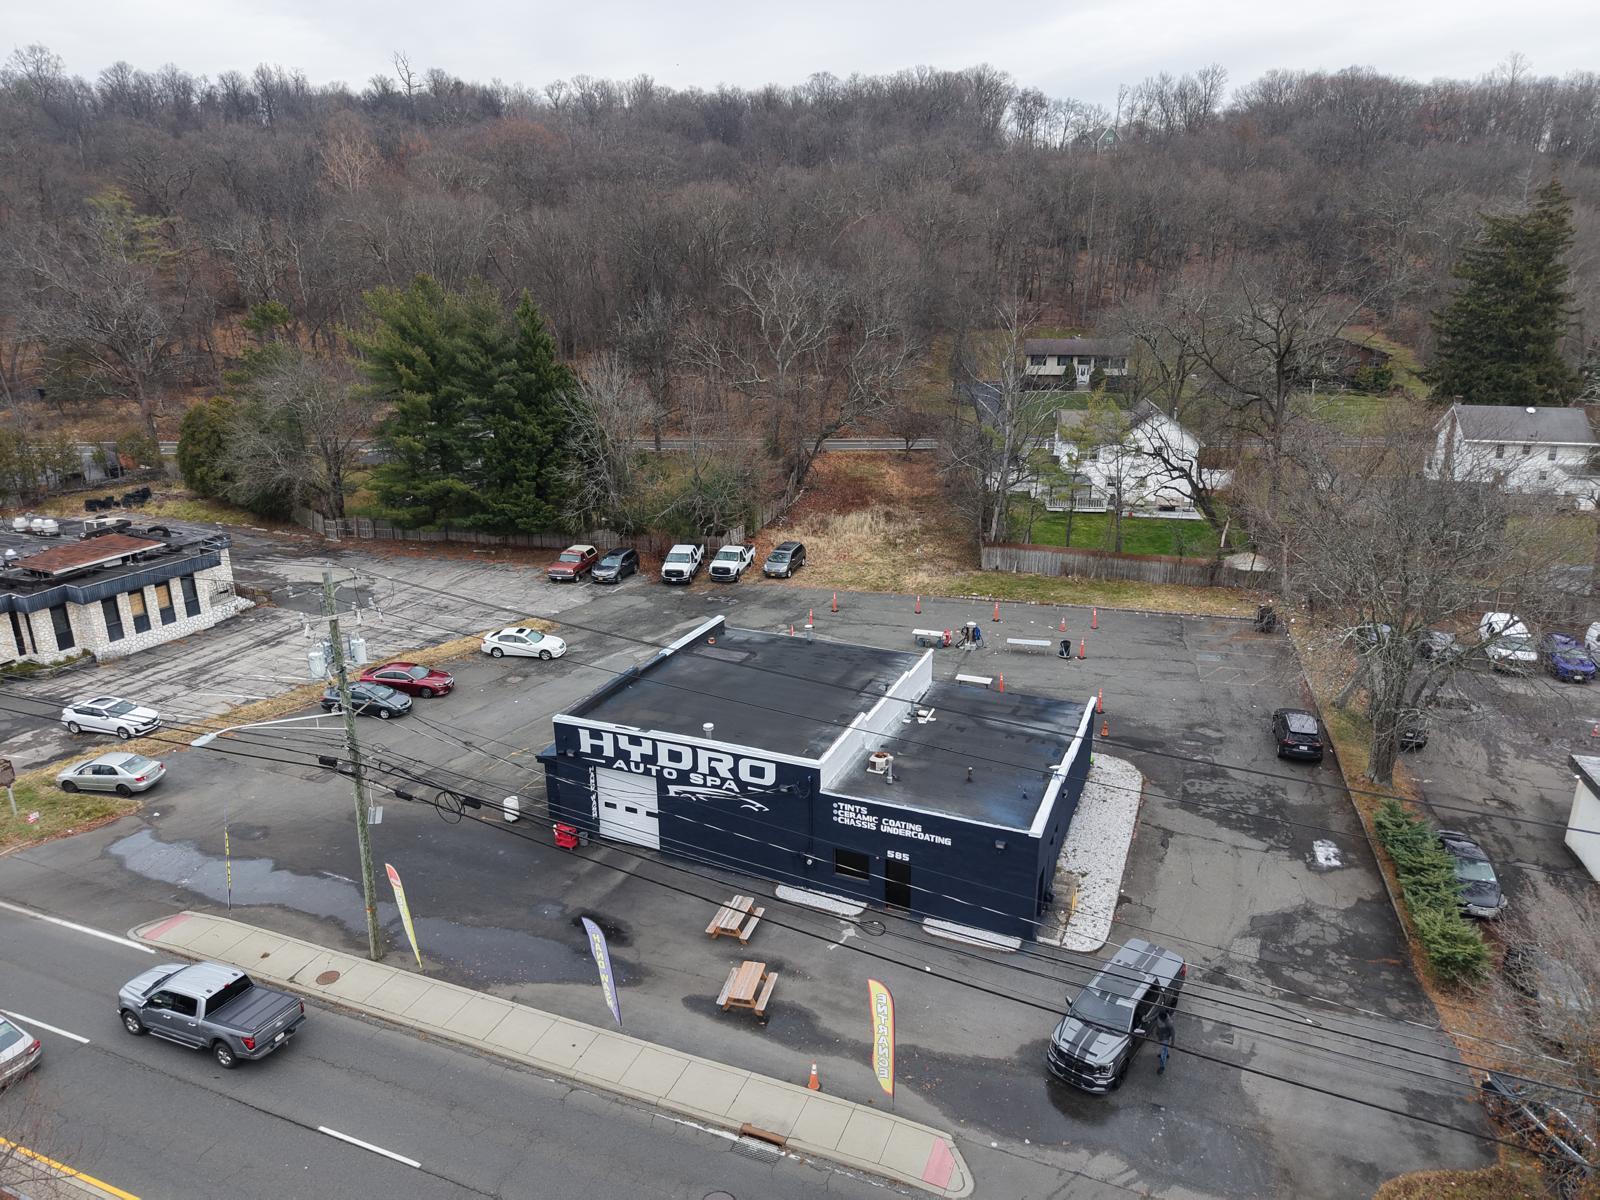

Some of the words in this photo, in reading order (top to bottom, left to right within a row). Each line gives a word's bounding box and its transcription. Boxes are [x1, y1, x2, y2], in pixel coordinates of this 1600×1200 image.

[578, 728, 776, 786] HYDRO
[612, 760, 678, 780] AUTO
[689, 772, 740, 792] SPA
[837, 809, 879, 824] CERAMIC
[881, 817, 923, 832] COATING
[838, 802, 868, 815] TINTS
[837, 816, 877, 831] CHASSIS
[880, 824, 952, 846] UNDERCOATING
[886, 849, 910, 862] 585
